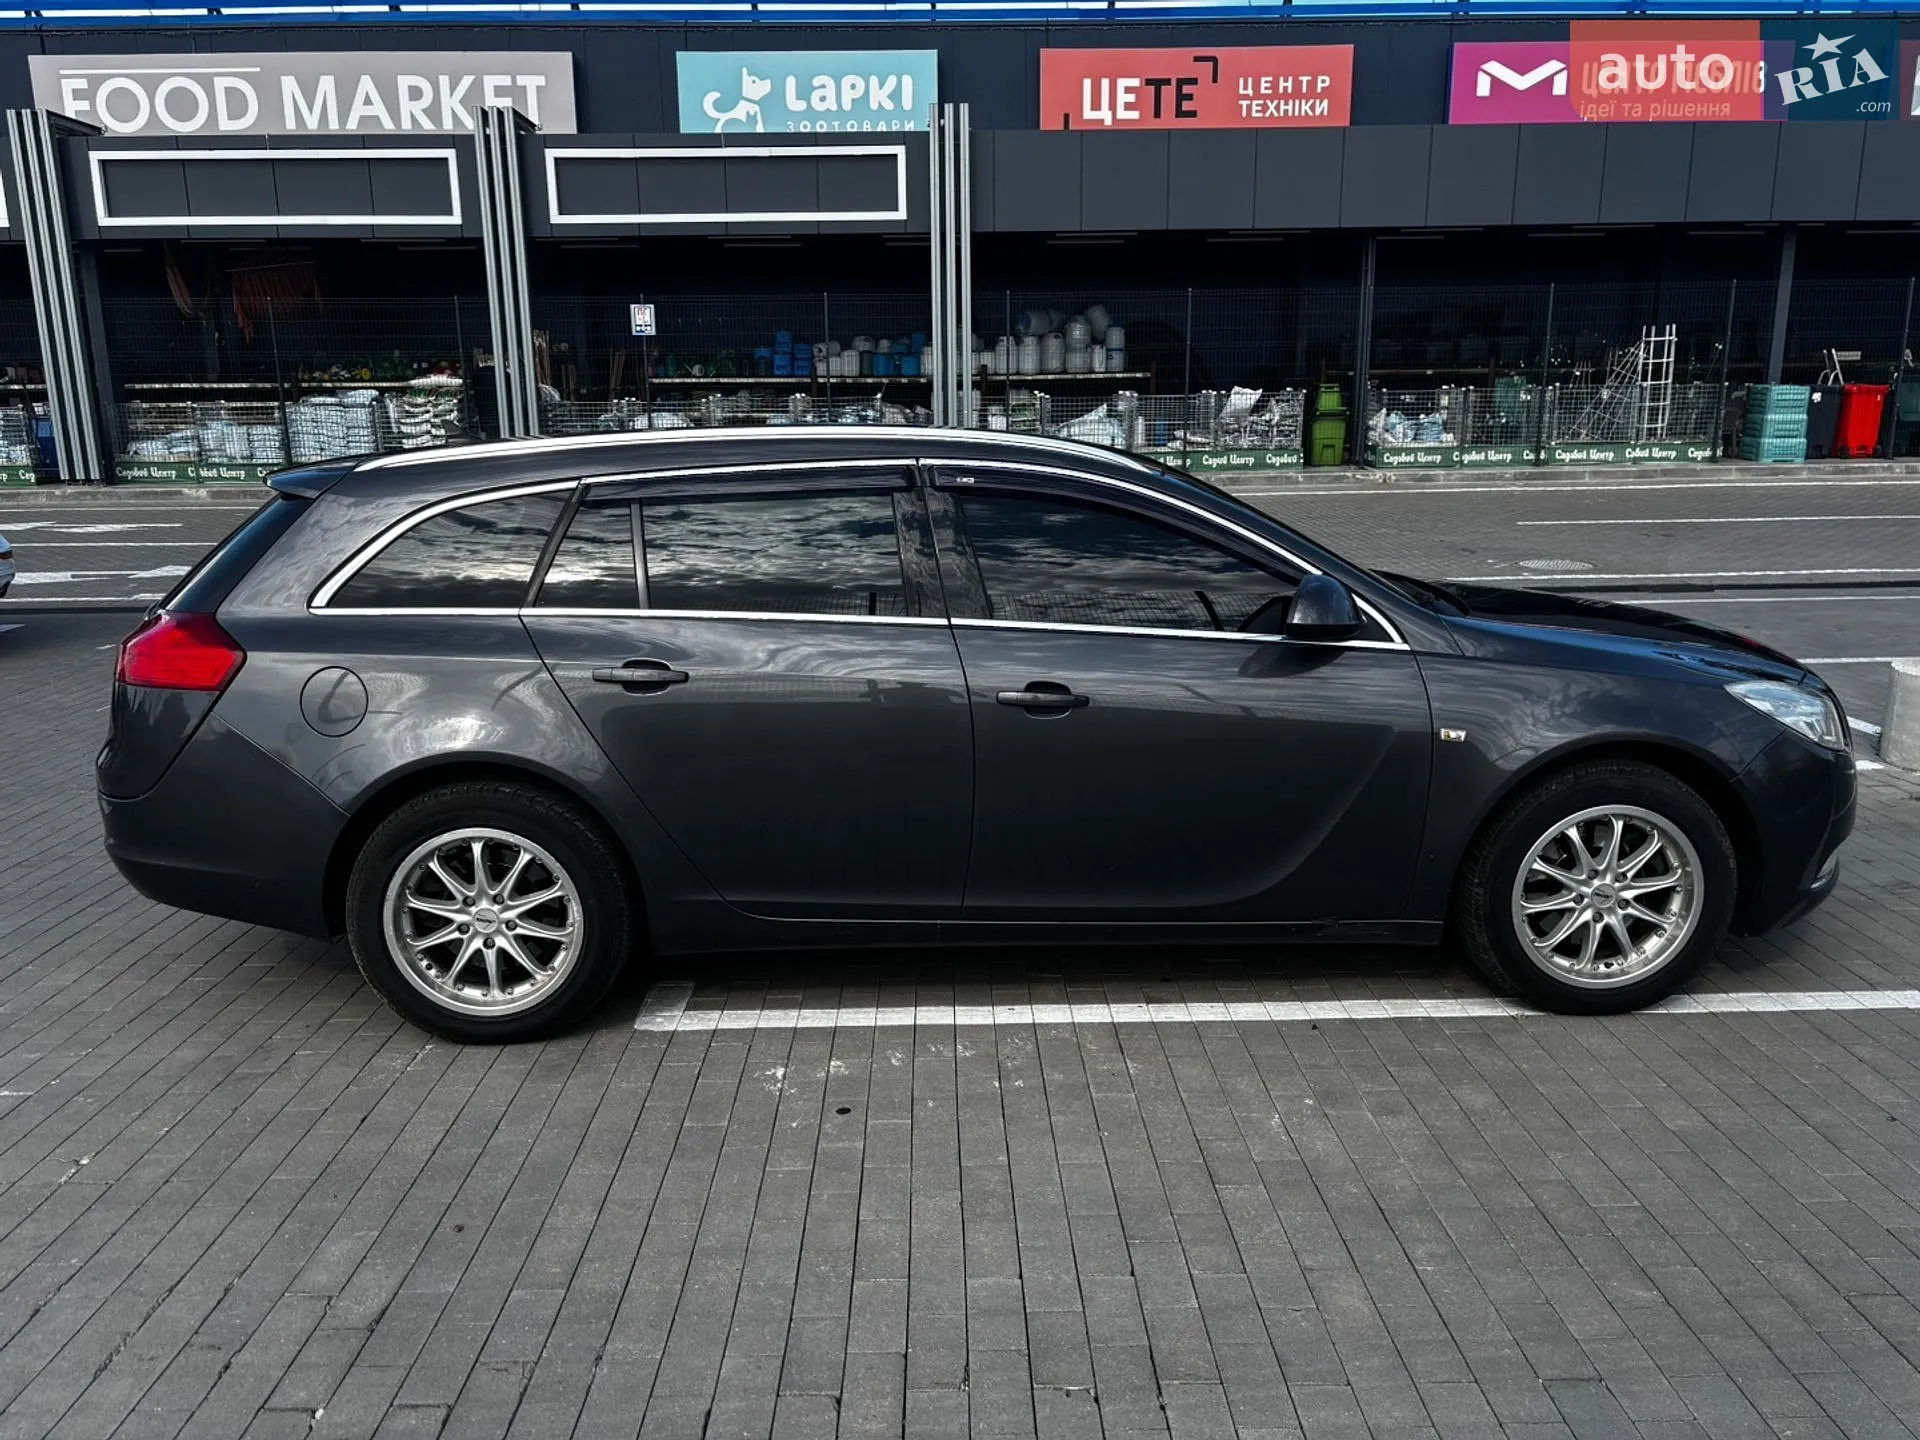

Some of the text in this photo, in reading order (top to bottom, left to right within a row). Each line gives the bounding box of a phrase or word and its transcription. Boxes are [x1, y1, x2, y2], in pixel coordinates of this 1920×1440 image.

[1238, 75, 1331, 97] ЦЕНТР
[61, 74, 547, 133] FOOD MARKET
[1083, 77, 1199, 126] ЦЕТЕ
[1238, 99, 1329, 118] ТЕХНІКИ
[1621, 103, 1642, 117] та
[786, 119, 915, 132] ЗООТОВАРИ
